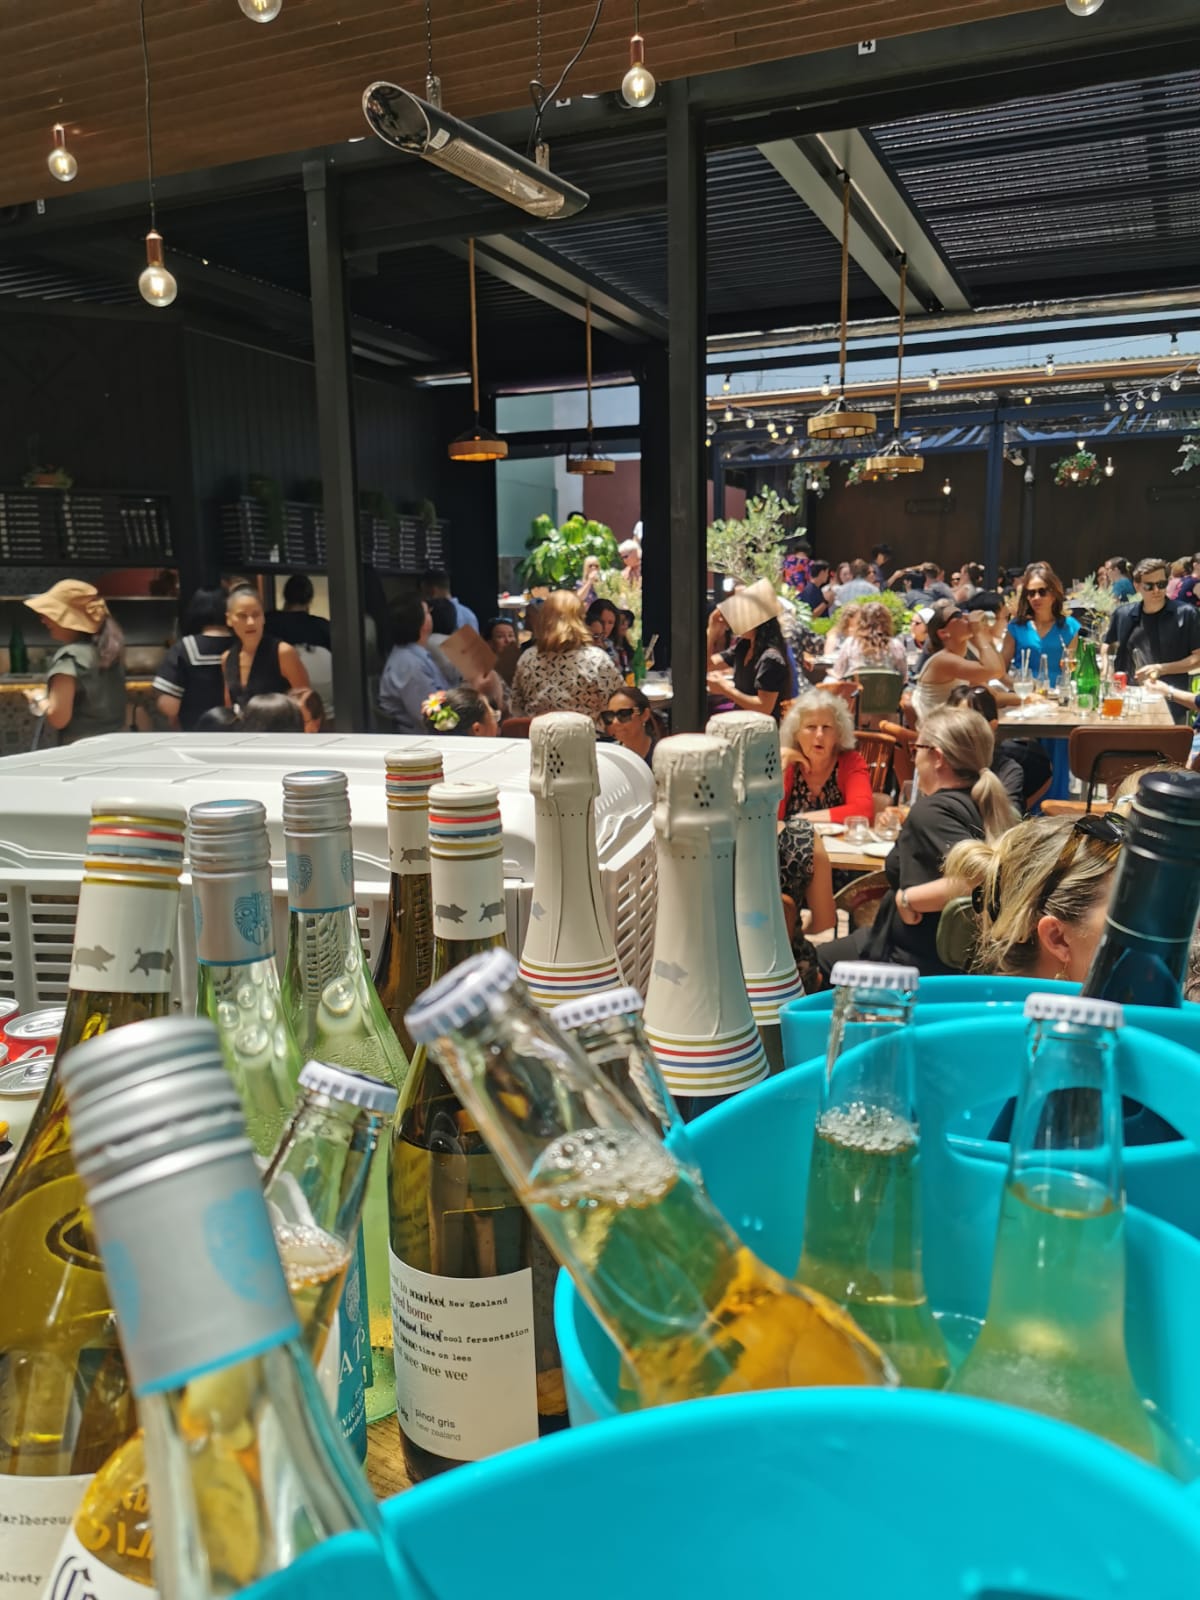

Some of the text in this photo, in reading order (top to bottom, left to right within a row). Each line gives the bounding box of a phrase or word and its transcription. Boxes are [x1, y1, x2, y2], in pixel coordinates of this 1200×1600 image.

[861, 40, 873, 51] 4
[409, 1291, 445, 1307] market
[449, 1297, 508, 1308] New Zealand
[406, 1299, 432, 1322] home
[443, 1327, 529, 1344] cool fermentation
[438, 1352, 449, 1360] on
[452, 1353, 472, 1362] lees
[420, 1362, 441, 1377] wee
[444, 1369, 468, 1381] wee
[415, 1408, 456, 1429] pinot gris
[431, 1428, 462, 1441] zealand
